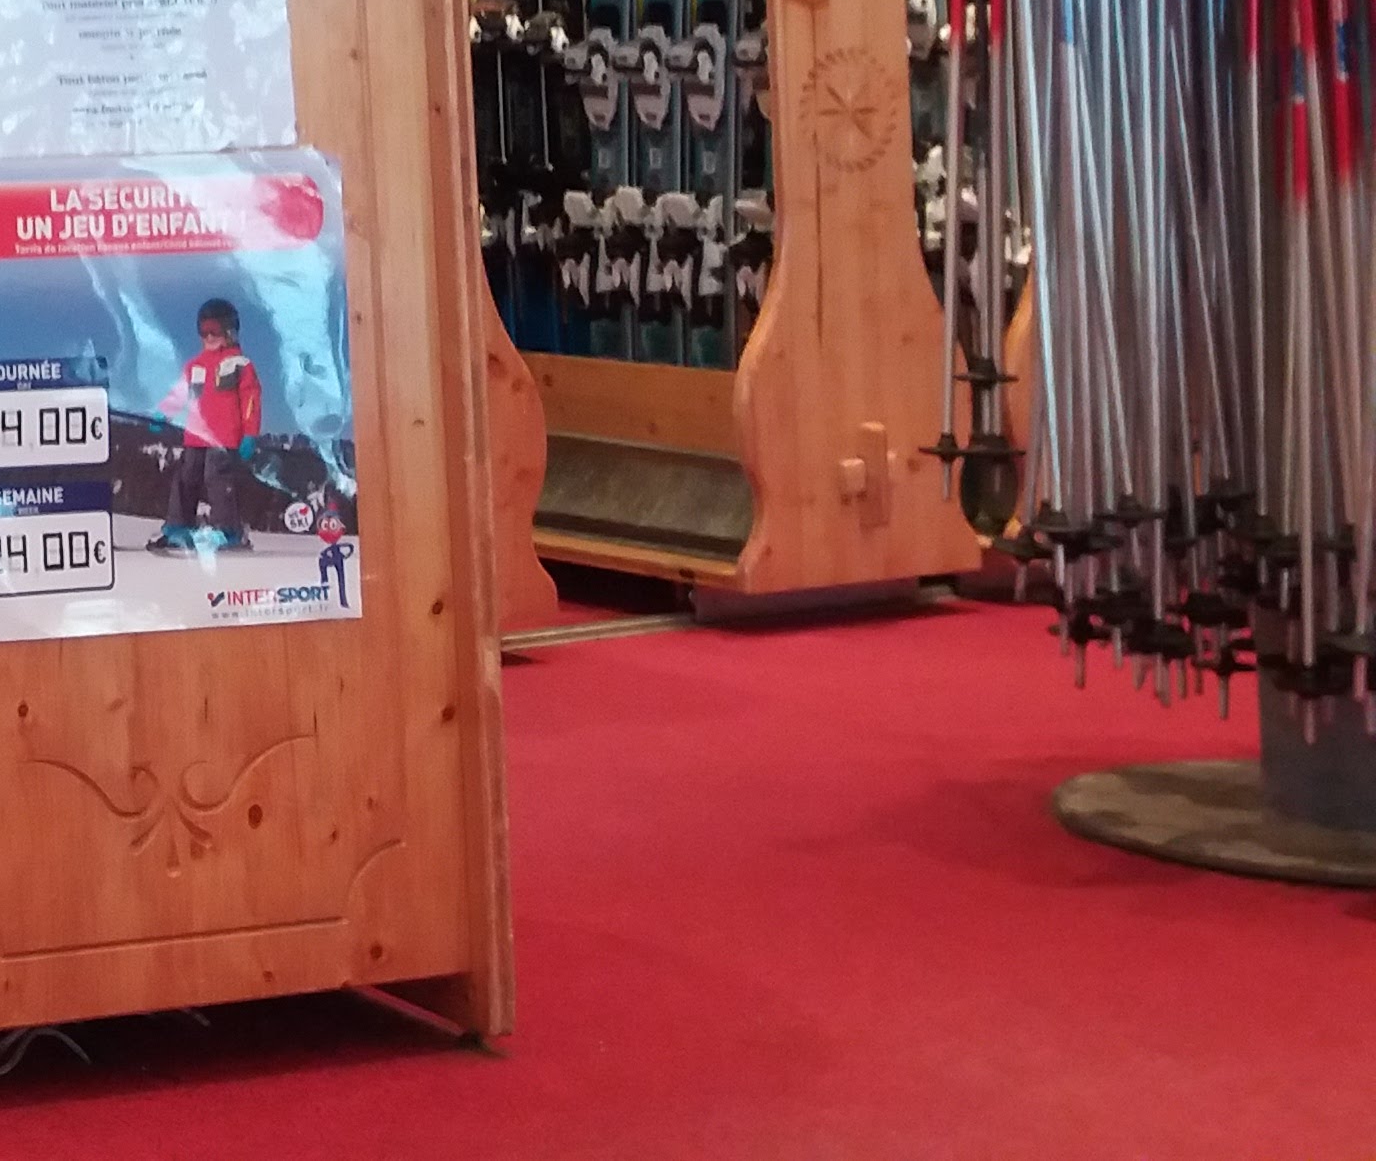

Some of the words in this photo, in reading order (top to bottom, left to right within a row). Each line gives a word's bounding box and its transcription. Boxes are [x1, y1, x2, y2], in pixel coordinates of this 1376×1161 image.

[50, 189, 82, 212] LA
[16, 216, 52, 240] UN
[59, 214, 105, 239] JEU
